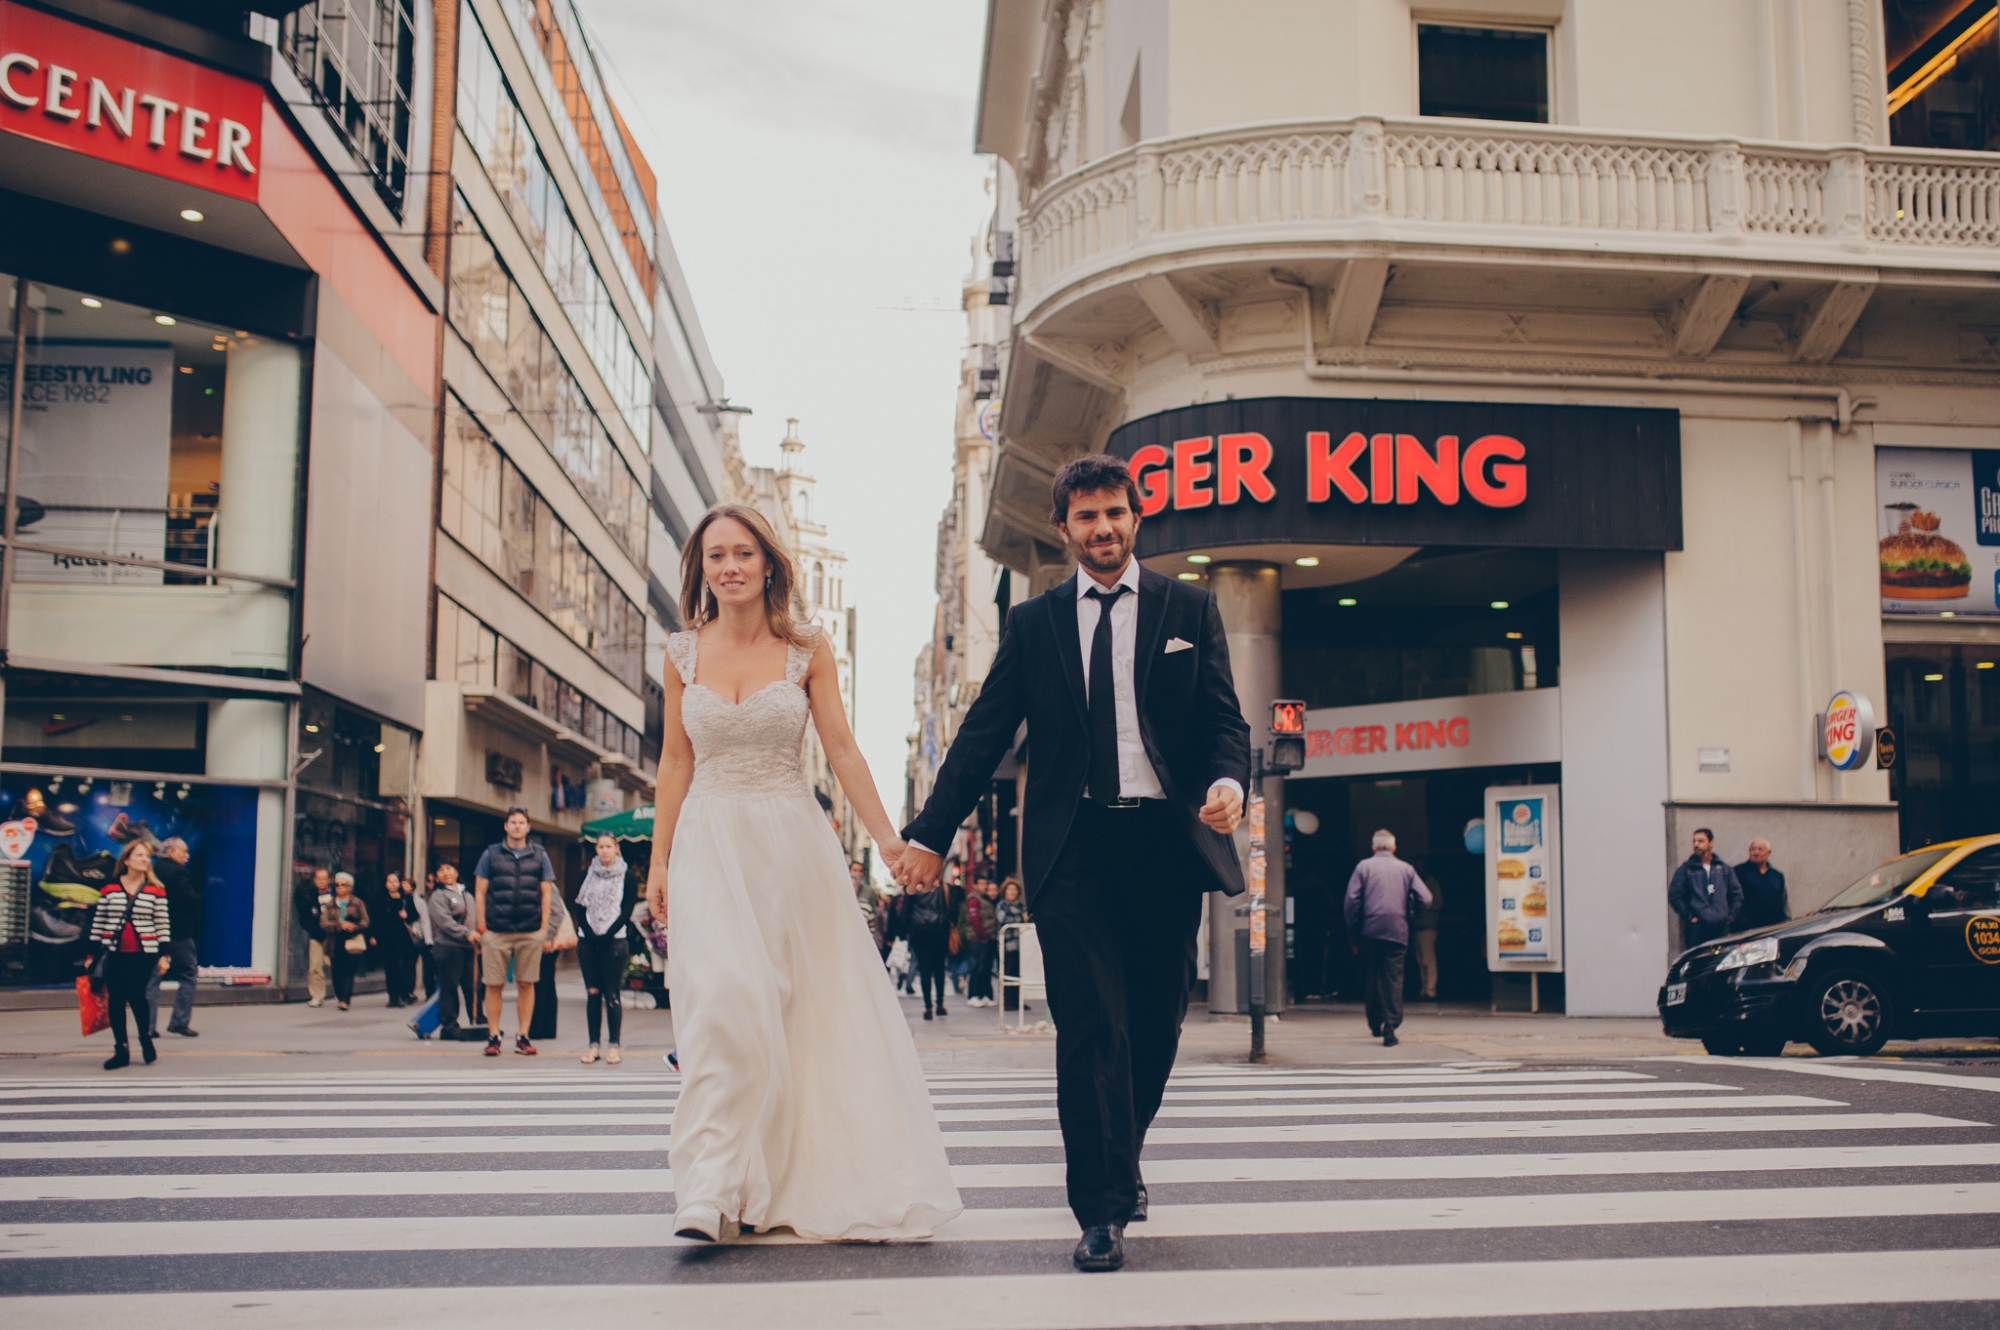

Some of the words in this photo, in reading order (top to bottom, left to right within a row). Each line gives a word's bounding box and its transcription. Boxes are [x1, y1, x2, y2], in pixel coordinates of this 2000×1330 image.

[0, 52, 257, 174] CENTER
[63, 383, 110, 403] 1982
[1307, 431, 1527, 508] KING
[1395, 716, 1469, 751] KING
[1973, 931, 2000, 945] 1034
